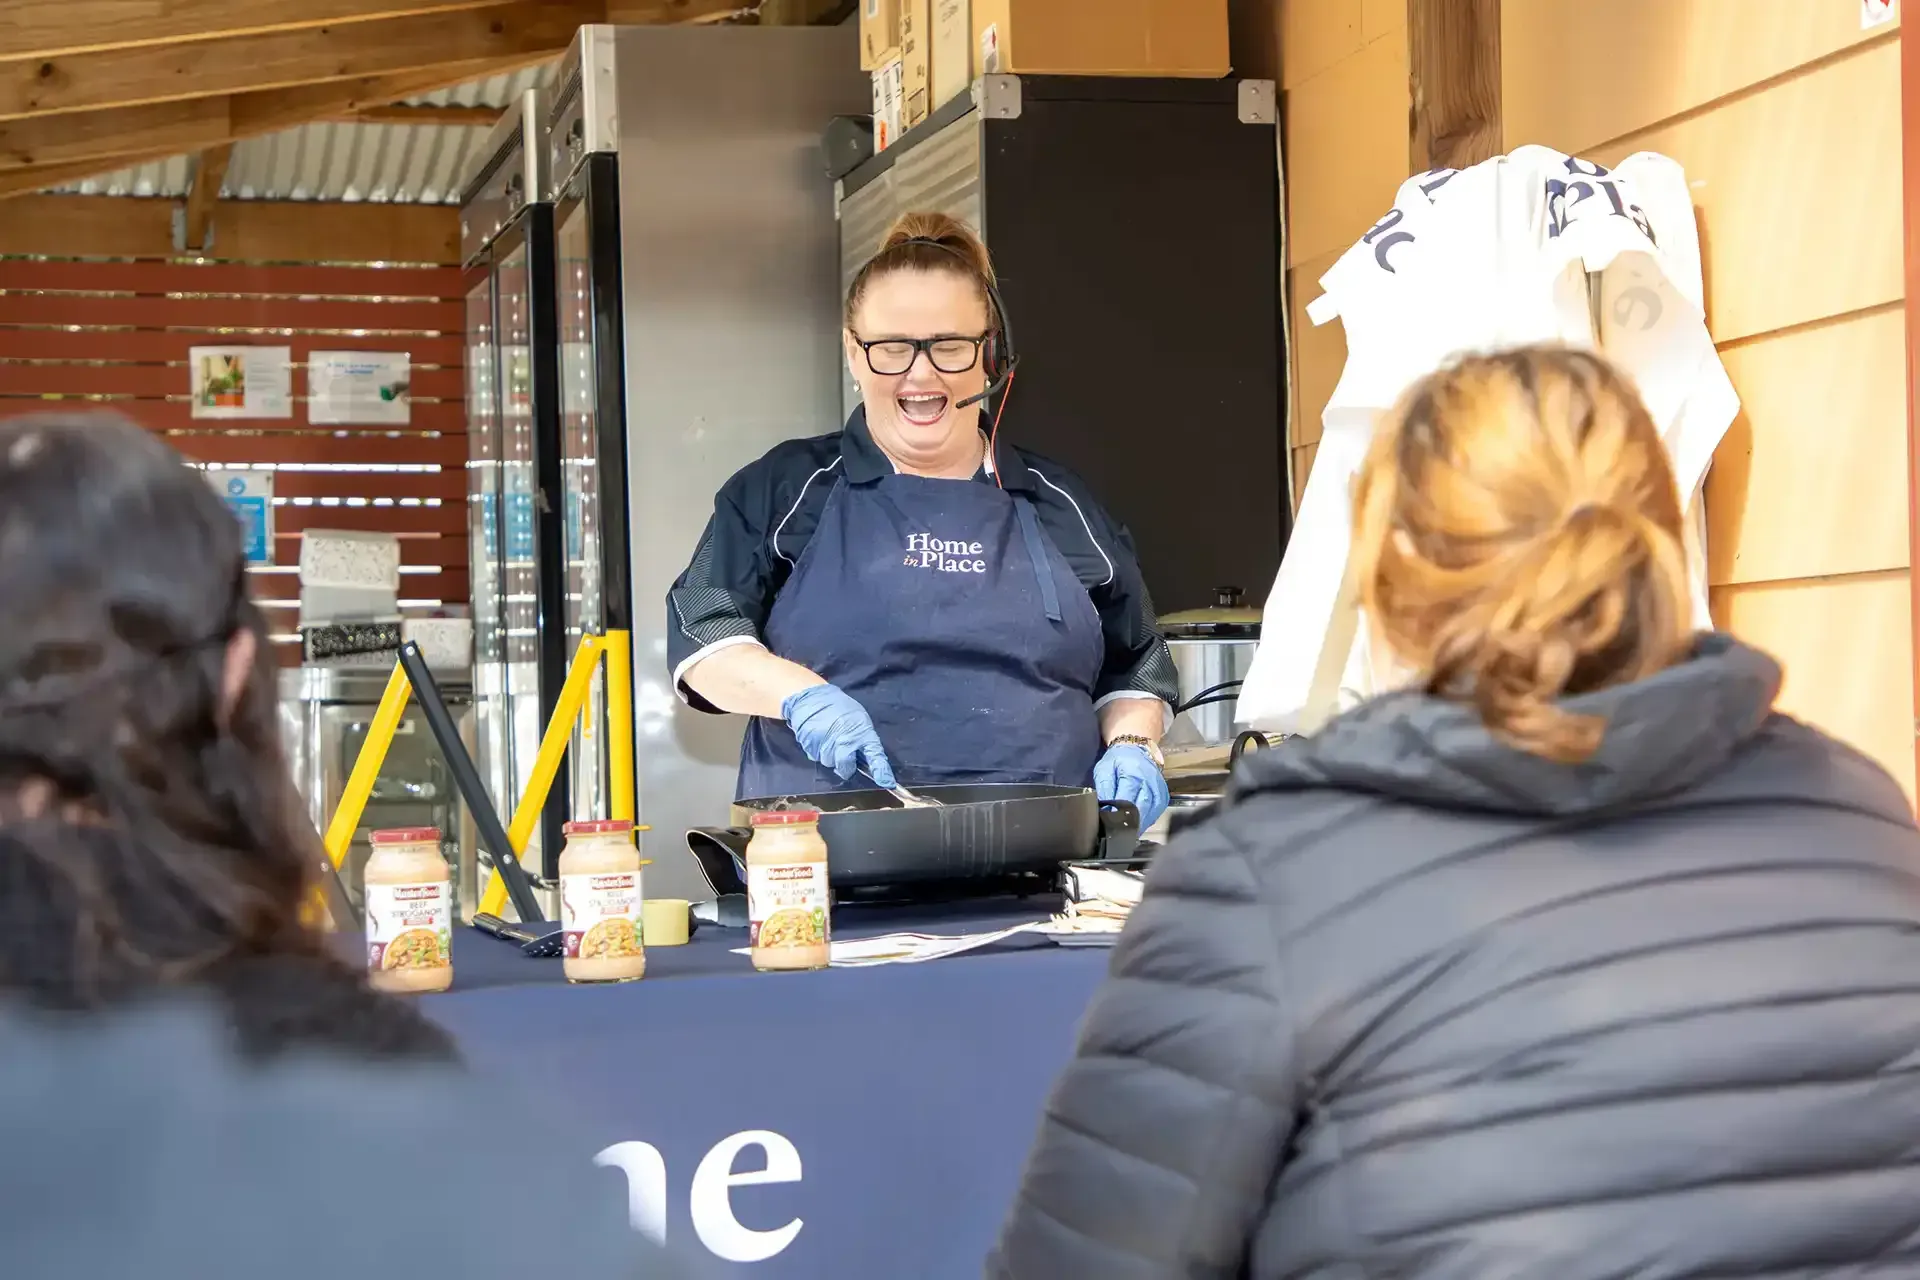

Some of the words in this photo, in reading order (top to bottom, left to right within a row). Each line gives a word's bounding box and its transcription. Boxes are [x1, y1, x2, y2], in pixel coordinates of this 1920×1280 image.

[906, 532, 983, 555] Home
[903, 555, 919, 567] in
[919, 550, 987, 573] Place
